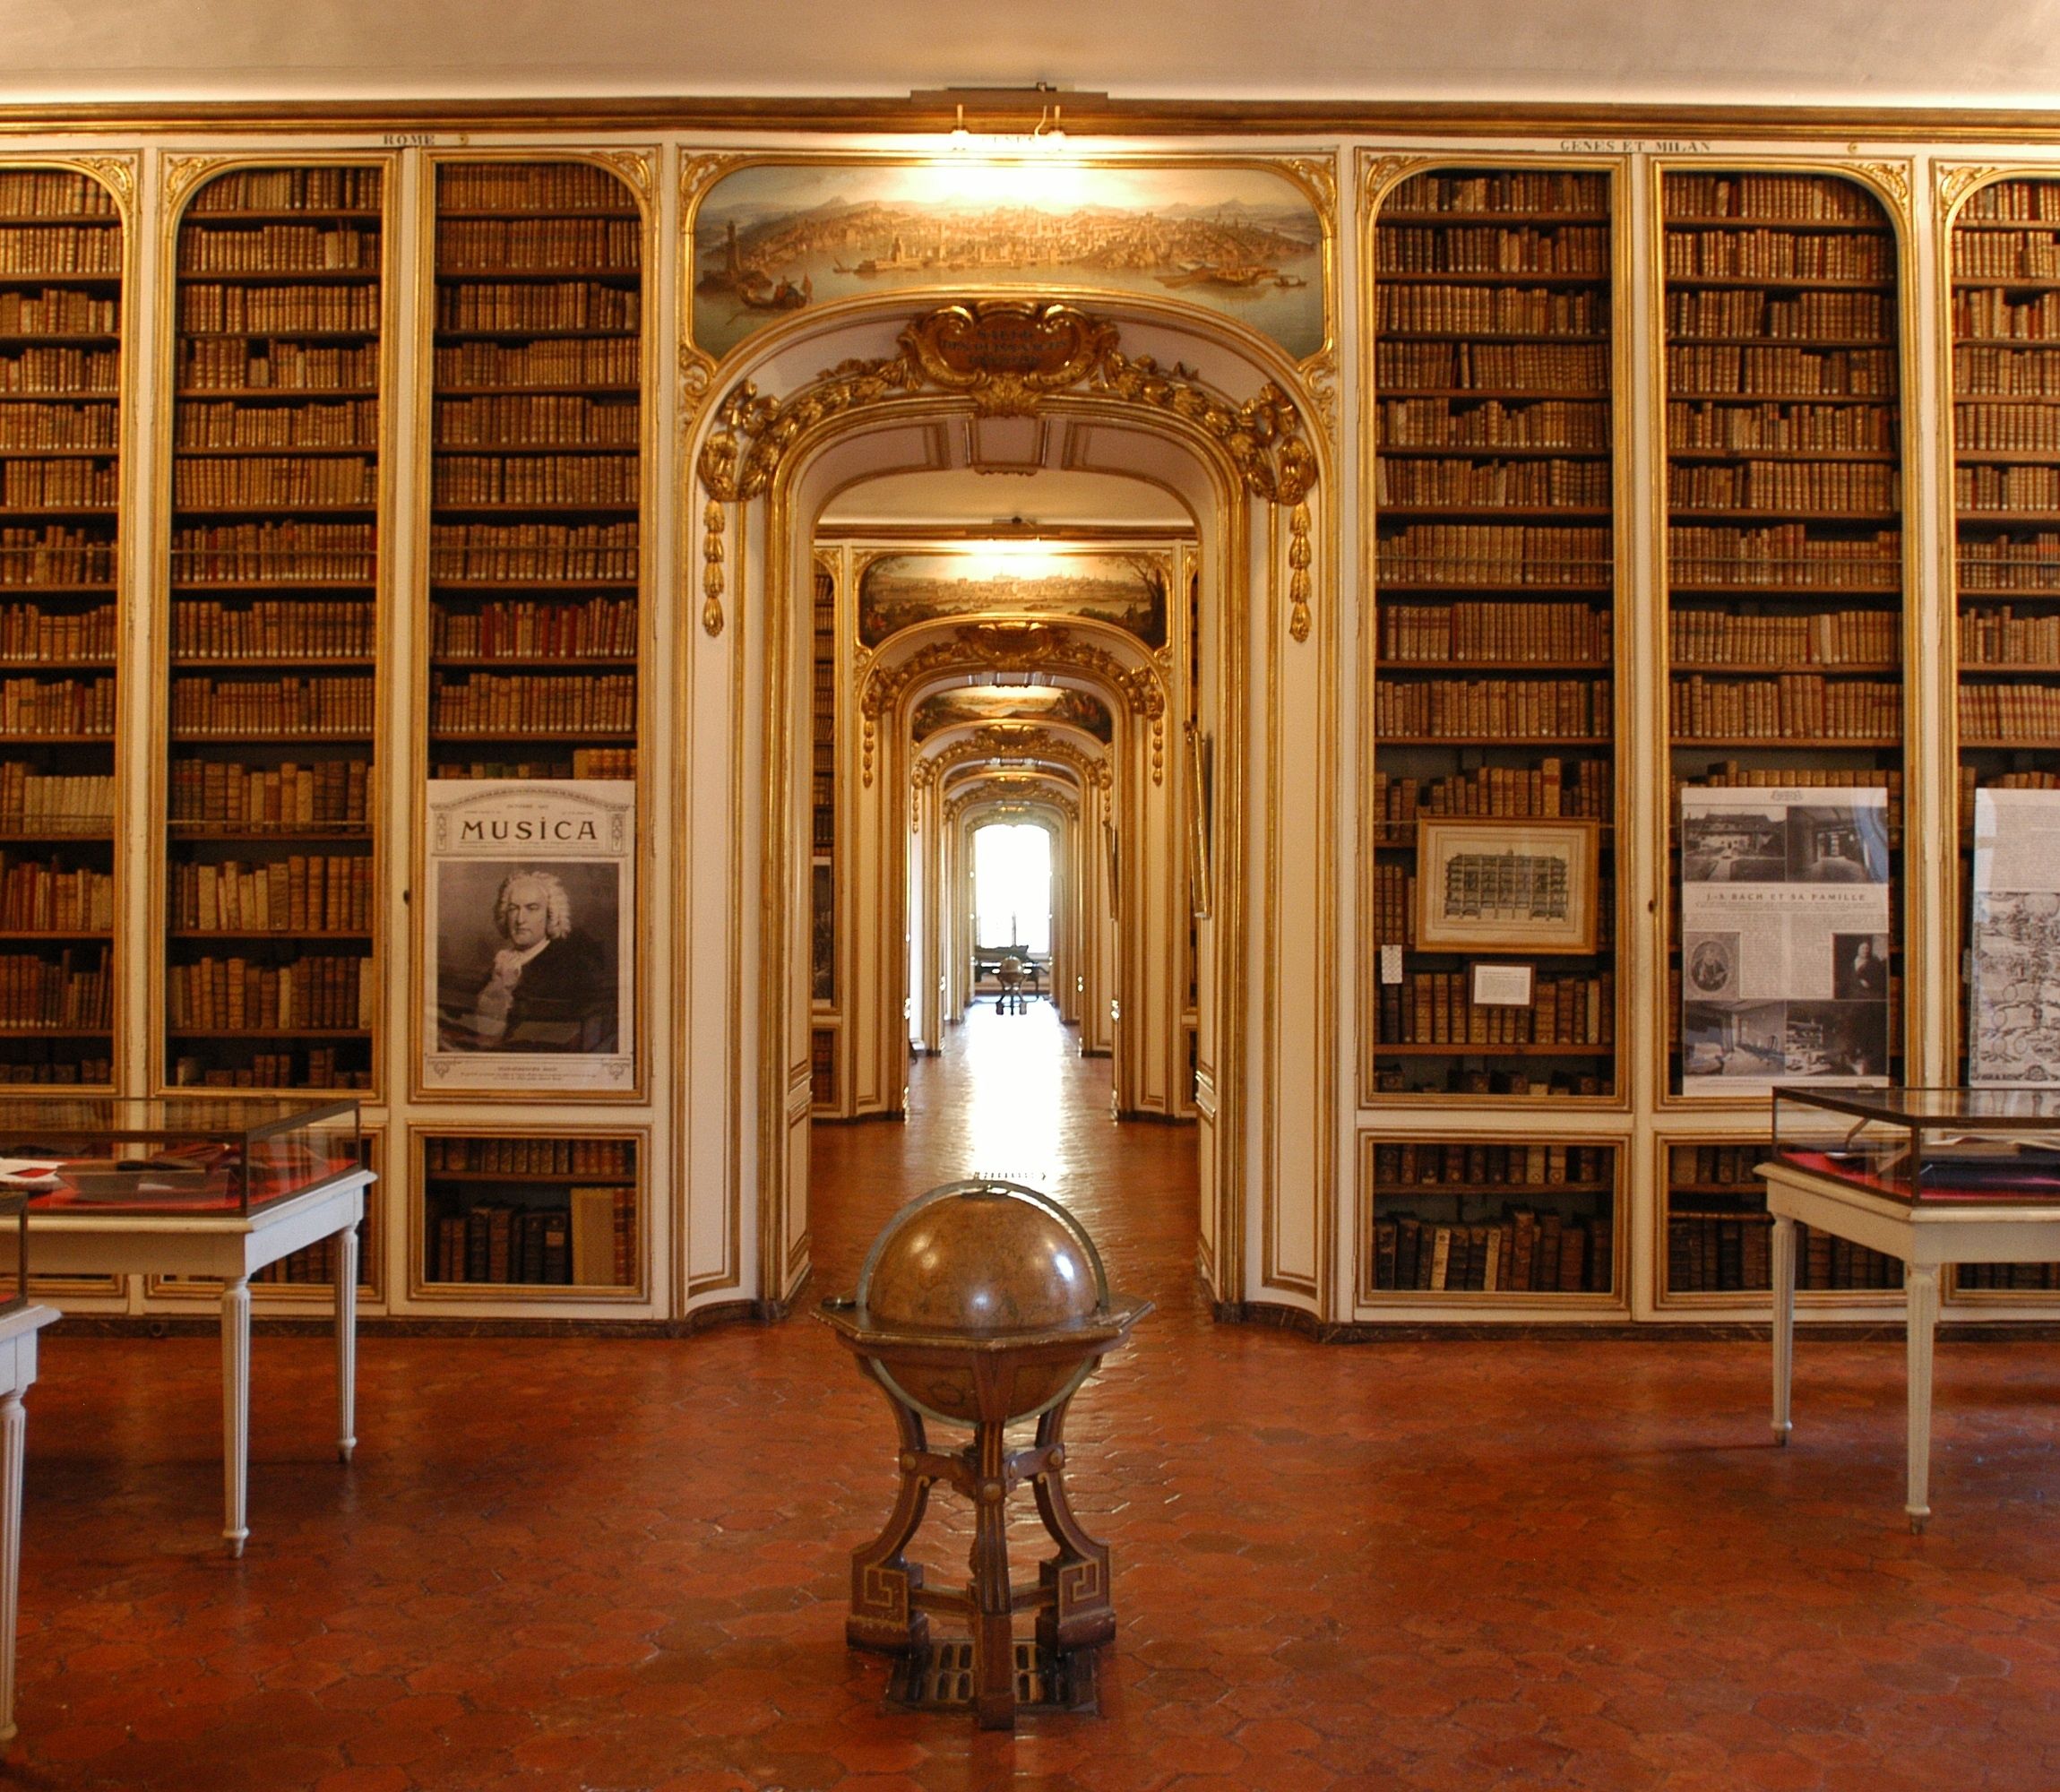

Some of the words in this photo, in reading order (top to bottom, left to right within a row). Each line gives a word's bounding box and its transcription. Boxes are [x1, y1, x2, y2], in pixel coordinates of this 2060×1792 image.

[384, 135, 435, 145] ROME
[1623, 141, 1645, 151] ET
[1657, 142, 1711, 151] MILAN
[1731, 892, 1763, 900] BACH
[1770, 892, 1784, 900] ET
[1811, 893, 1866, 901] FAMILLE
